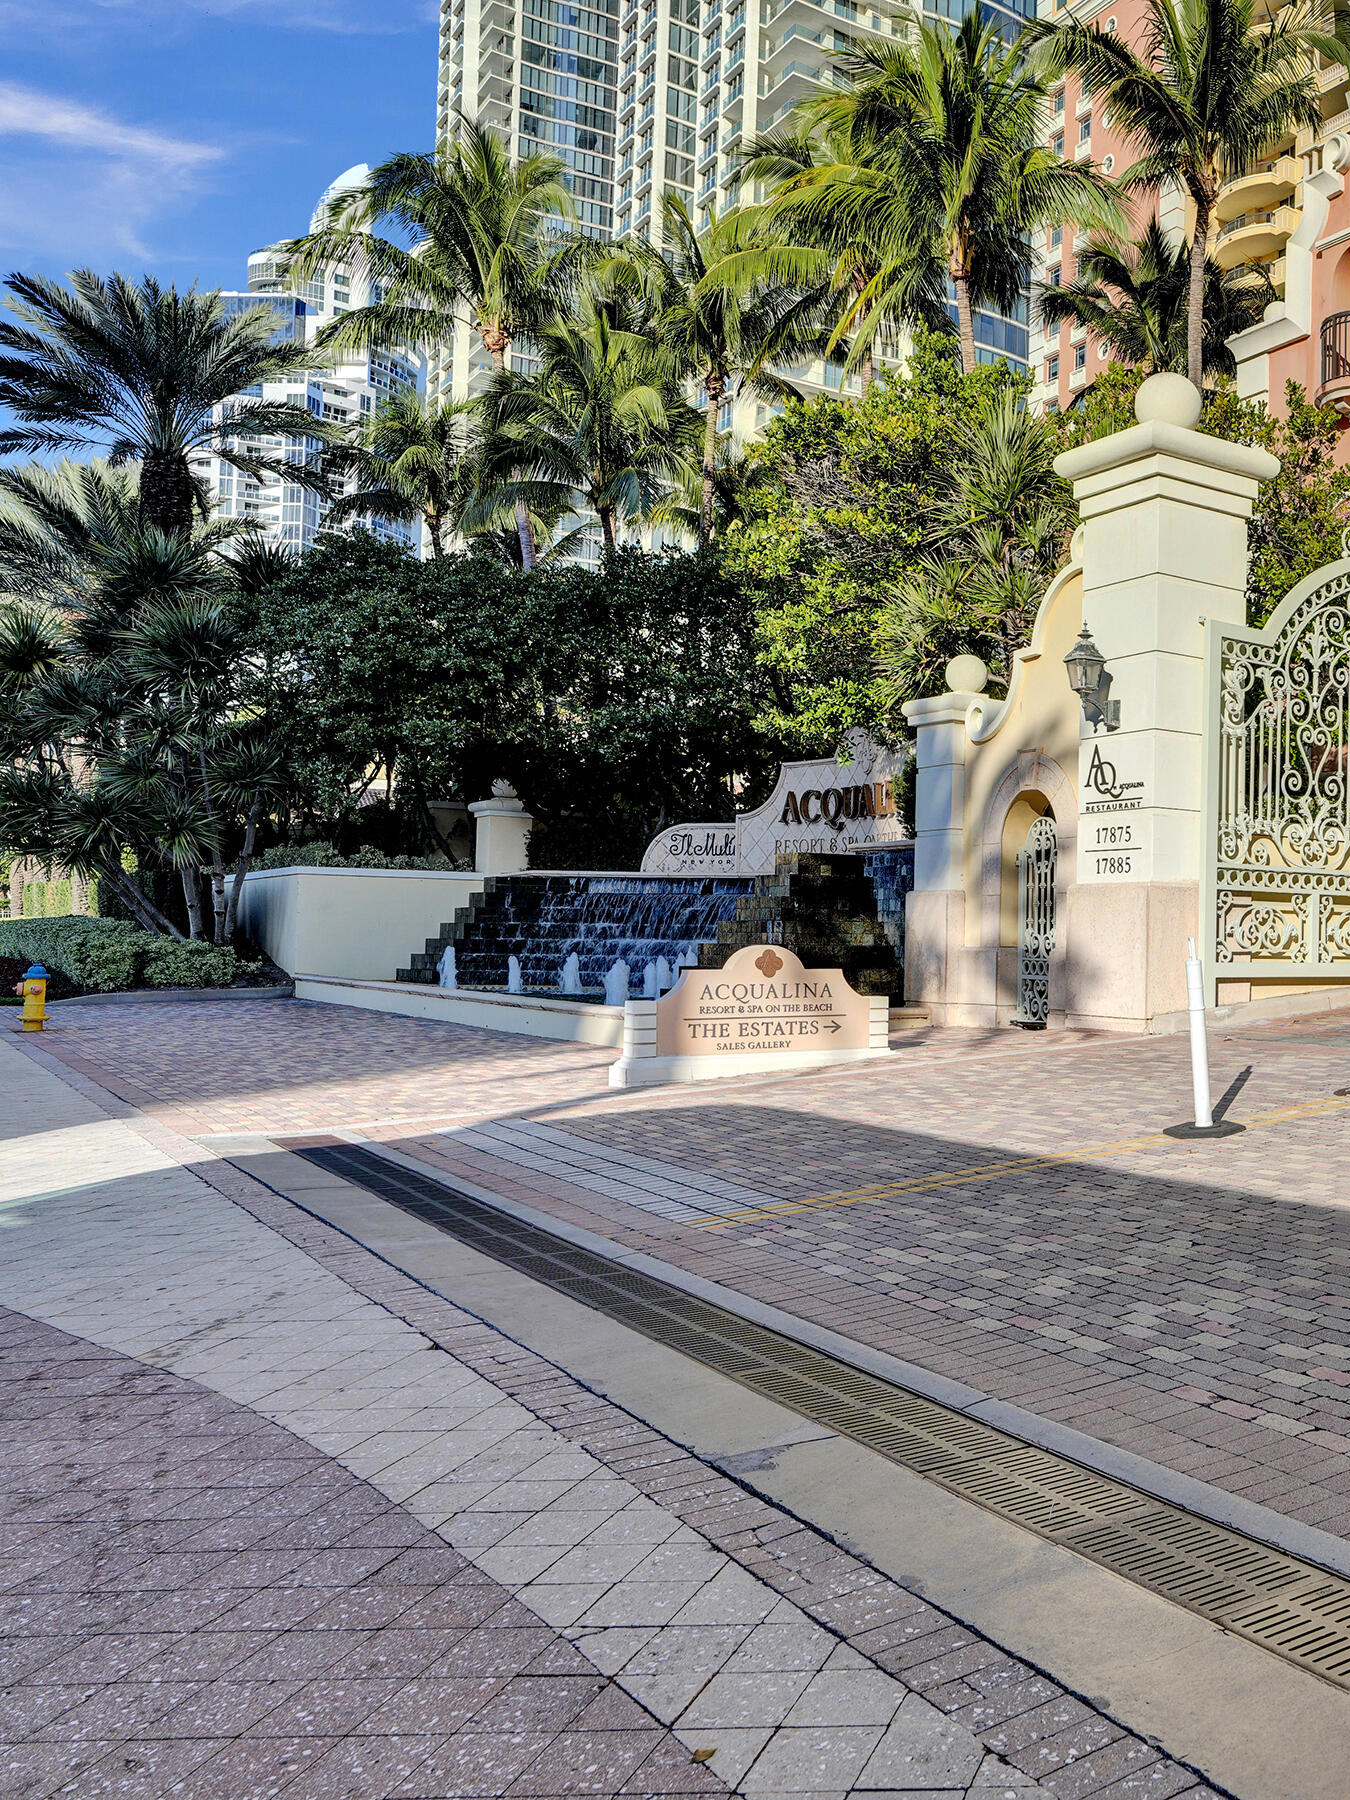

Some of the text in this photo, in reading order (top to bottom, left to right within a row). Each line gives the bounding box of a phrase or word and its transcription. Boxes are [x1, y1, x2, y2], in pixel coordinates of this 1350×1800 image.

[1084, 743, 1124, 799] AQ
[1086, 801, 1141, 813] RESTAURANT
[1095, 825, 1132, 844] 17875
[829, 837, 838, 853] &
[1095, 856, 1132, 874] 17885
[699, 982, 833, 1004] ACQUALINA
[699, 1004, 833, 1014] RESORT & SPA ON THE BEACH
[688, 1020, 820, 1039] THE ESTATES
[716, 1040, 792, 1051] SALES GALLERY
